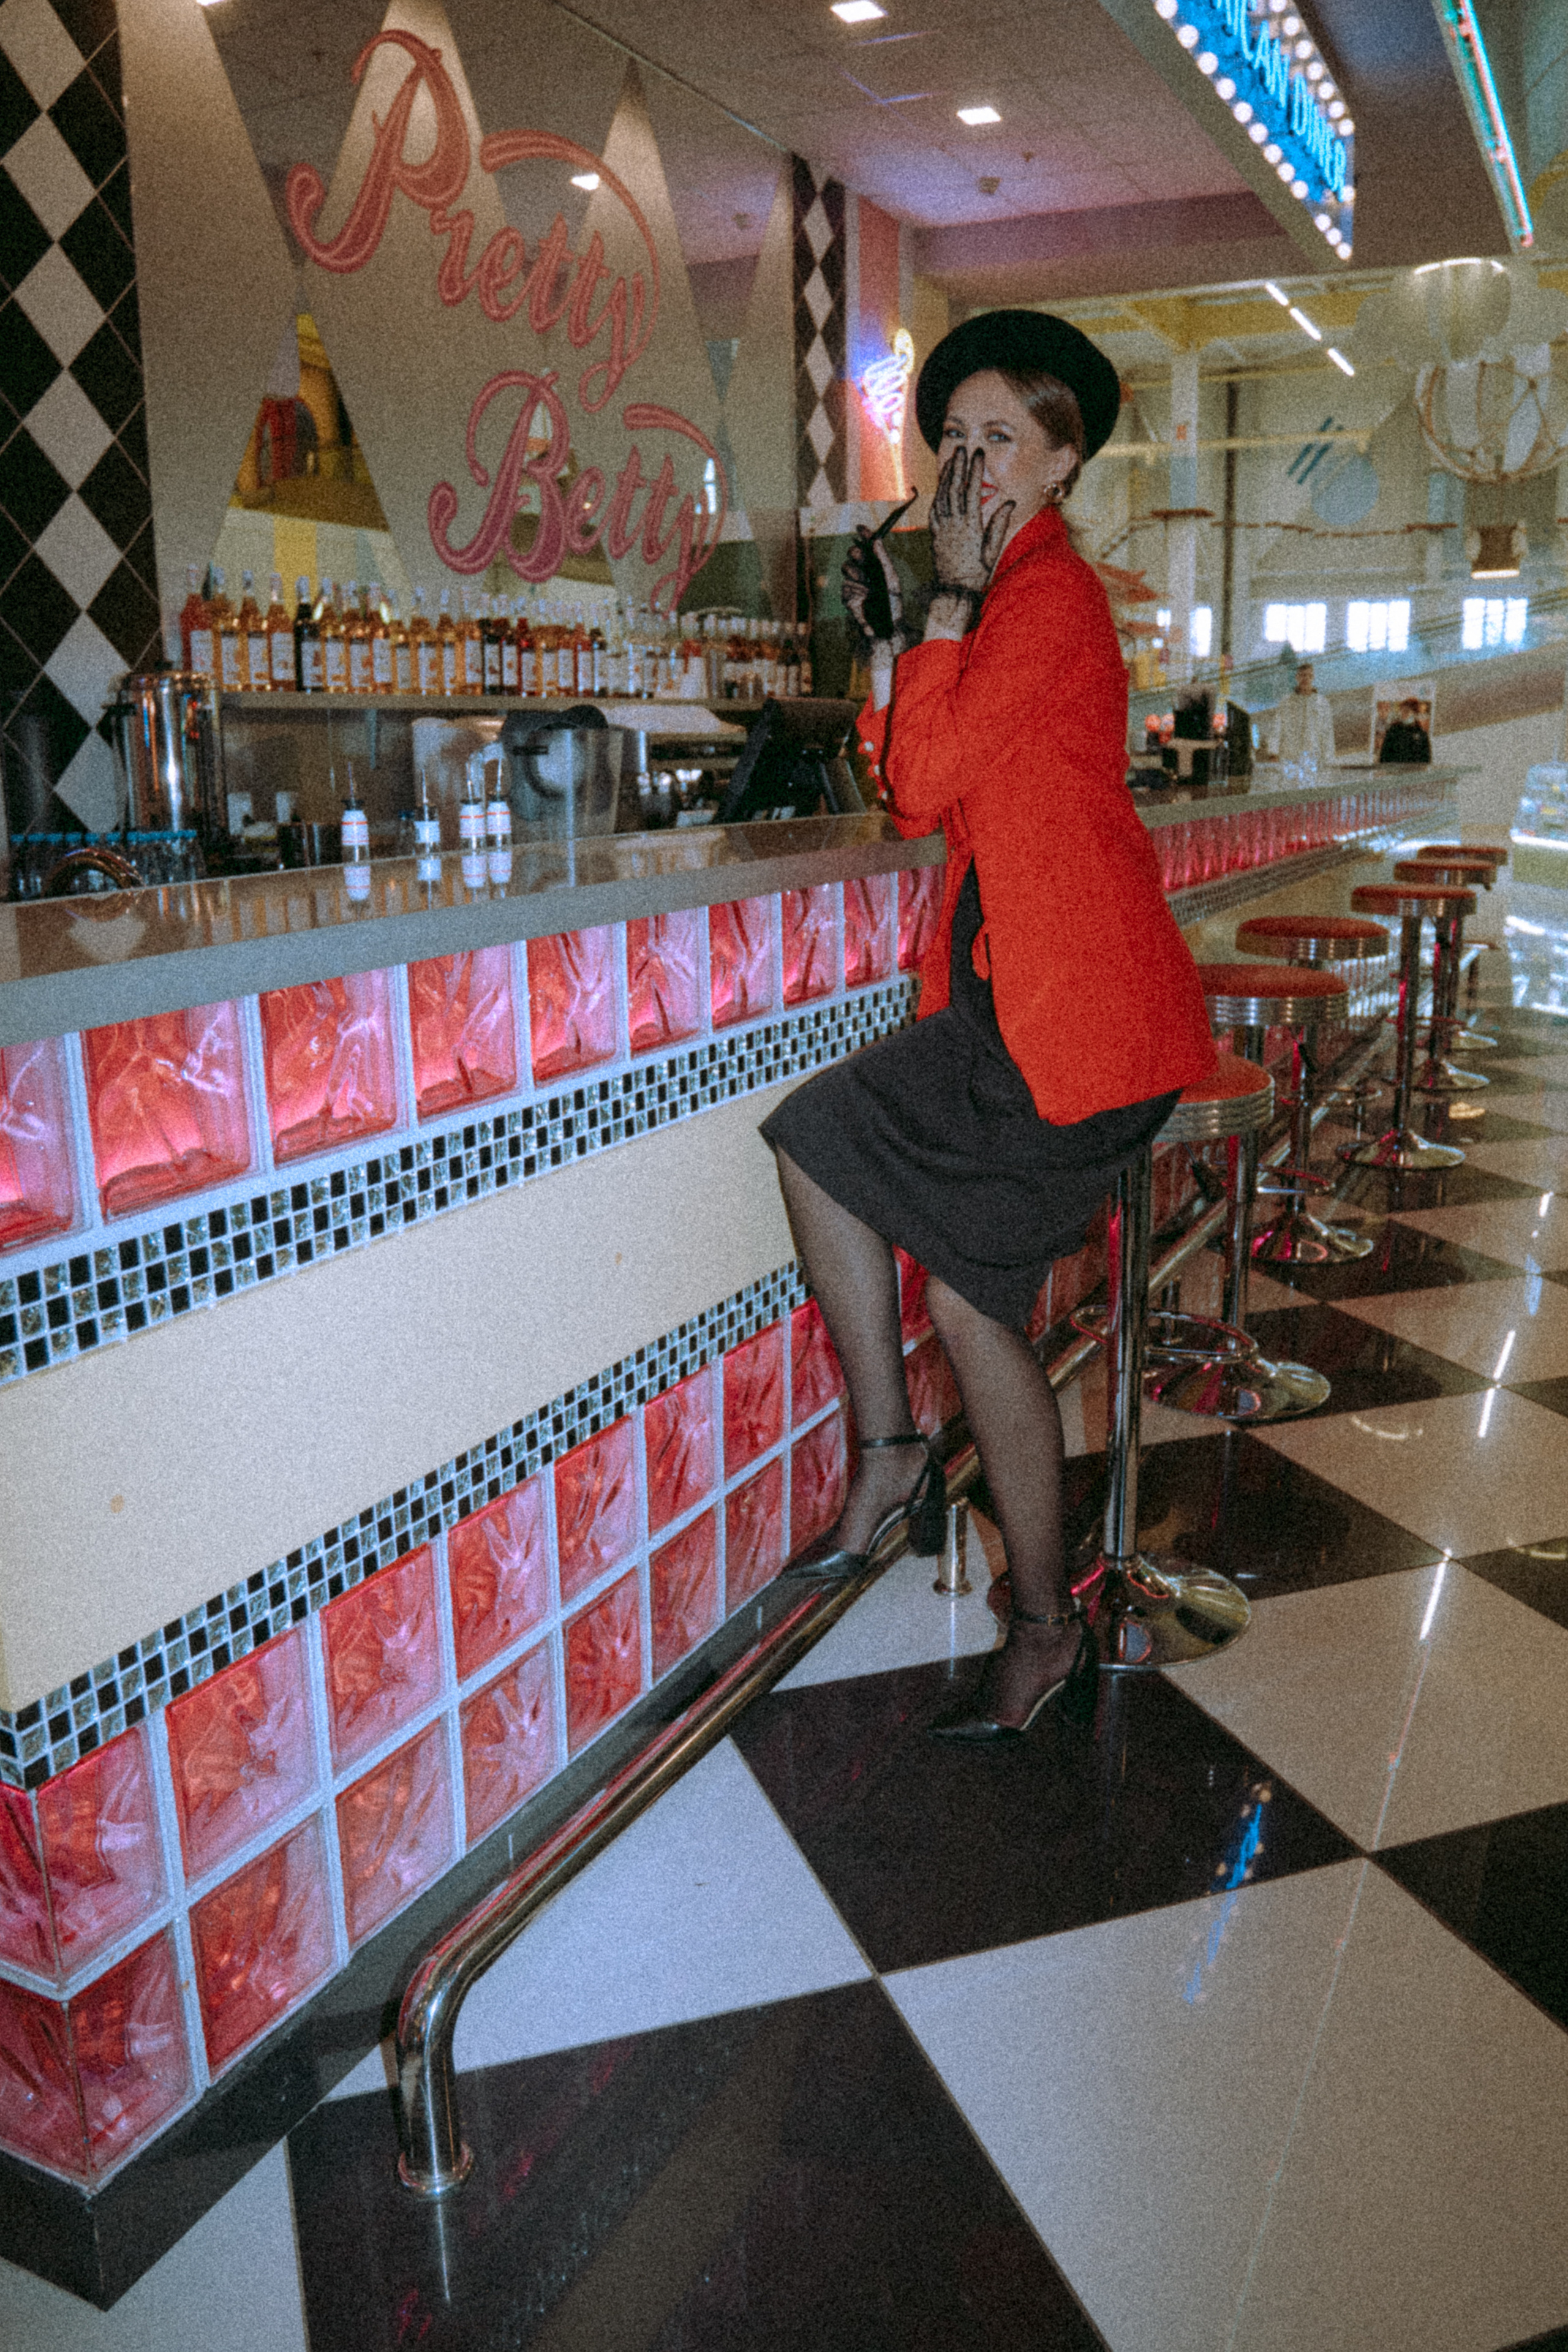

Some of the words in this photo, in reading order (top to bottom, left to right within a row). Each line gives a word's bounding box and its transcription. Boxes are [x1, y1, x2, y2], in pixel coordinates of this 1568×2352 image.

[286, 29, 660, 413] Pretty
[1292, 72, 1347, 203] DINER
[428, 369, 729, 620] Betty
